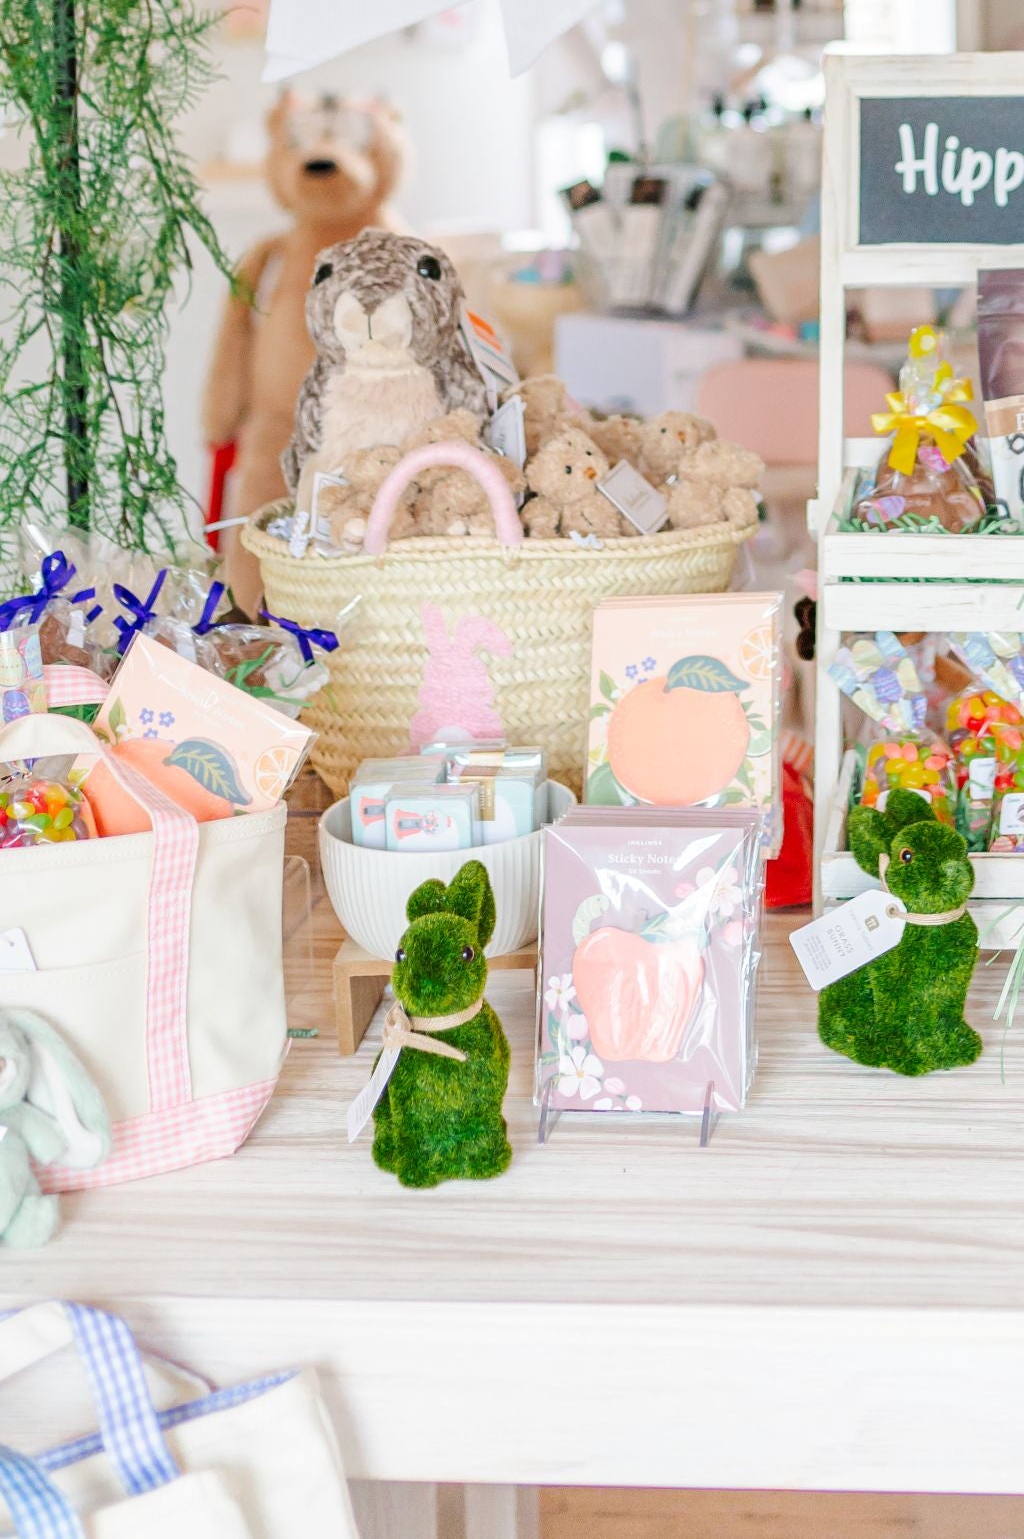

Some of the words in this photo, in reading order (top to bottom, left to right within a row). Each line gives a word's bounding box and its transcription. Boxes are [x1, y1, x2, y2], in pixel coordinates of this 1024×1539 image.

[607, 853, 643, 866] Sticky
[826, 928, 847, 958] BUNNY
[835, 924, 855, 955] GRASS
